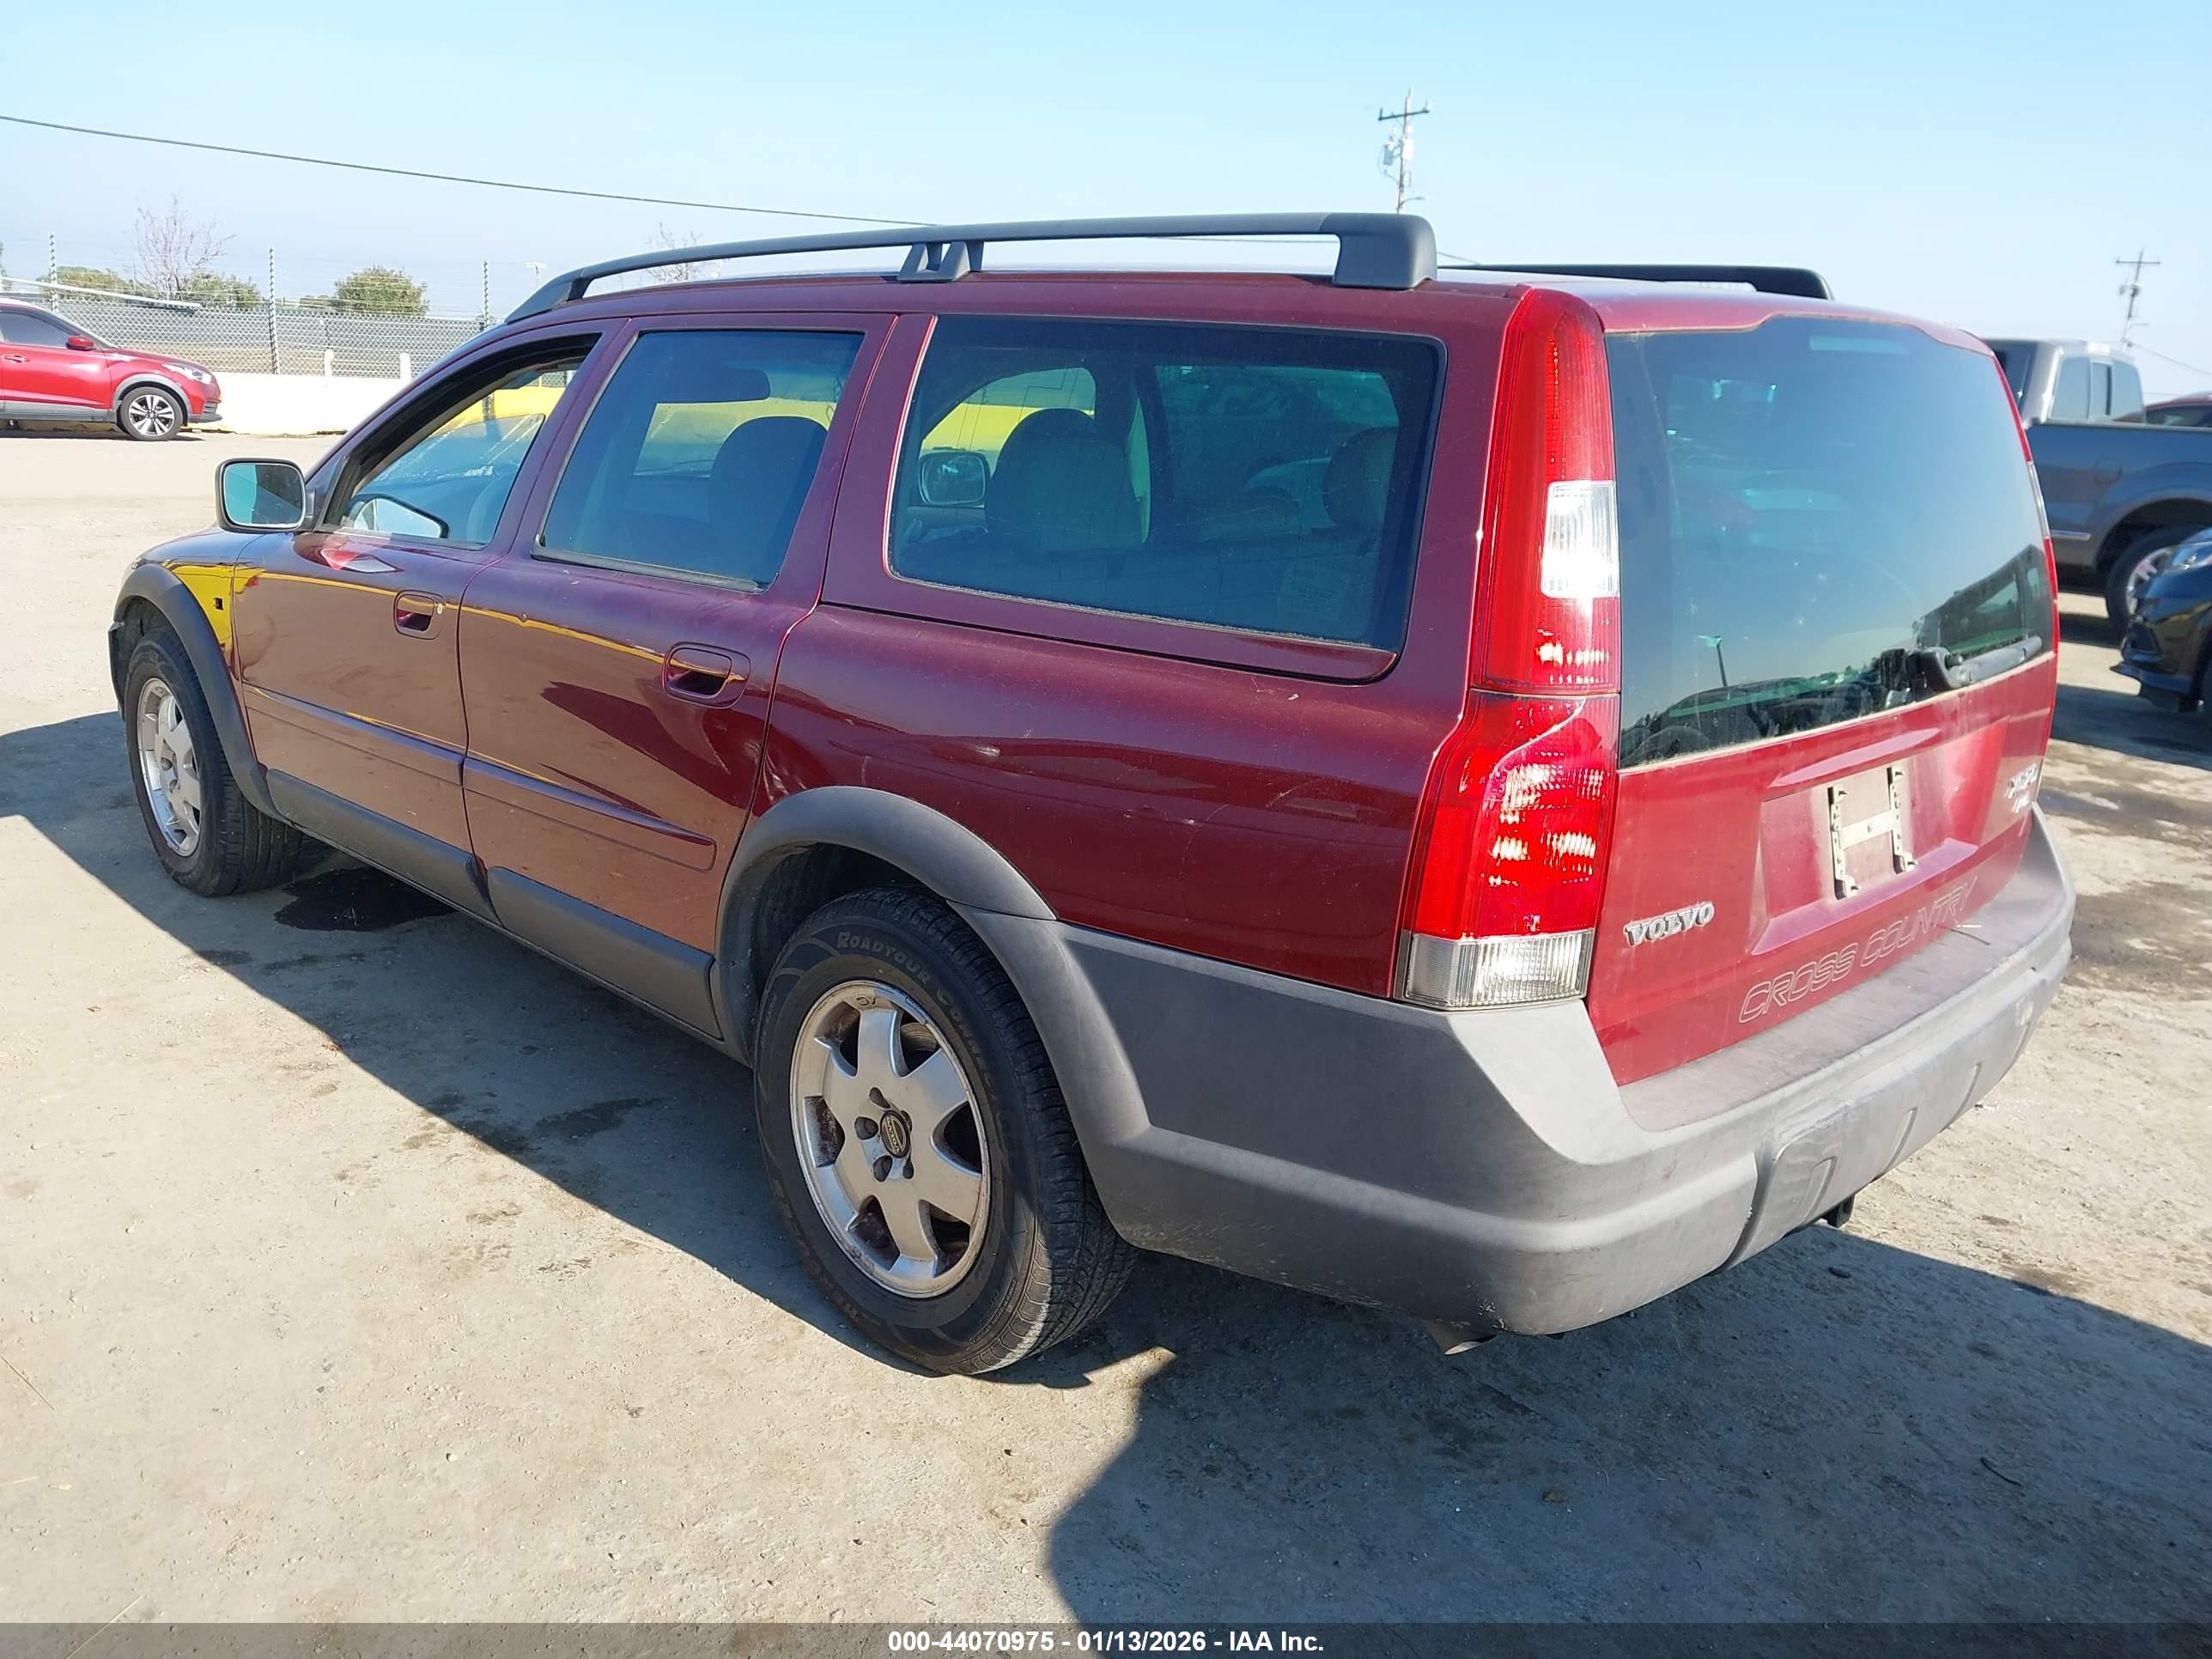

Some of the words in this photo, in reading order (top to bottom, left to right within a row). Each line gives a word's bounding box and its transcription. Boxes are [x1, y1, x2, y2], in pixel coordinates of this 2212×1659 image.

[1624, 901, 1714, 945] VOLVO
[1739, 942, 1858, 1023] CROSS
[1861, 877, 1978, 967] COUNTRY
